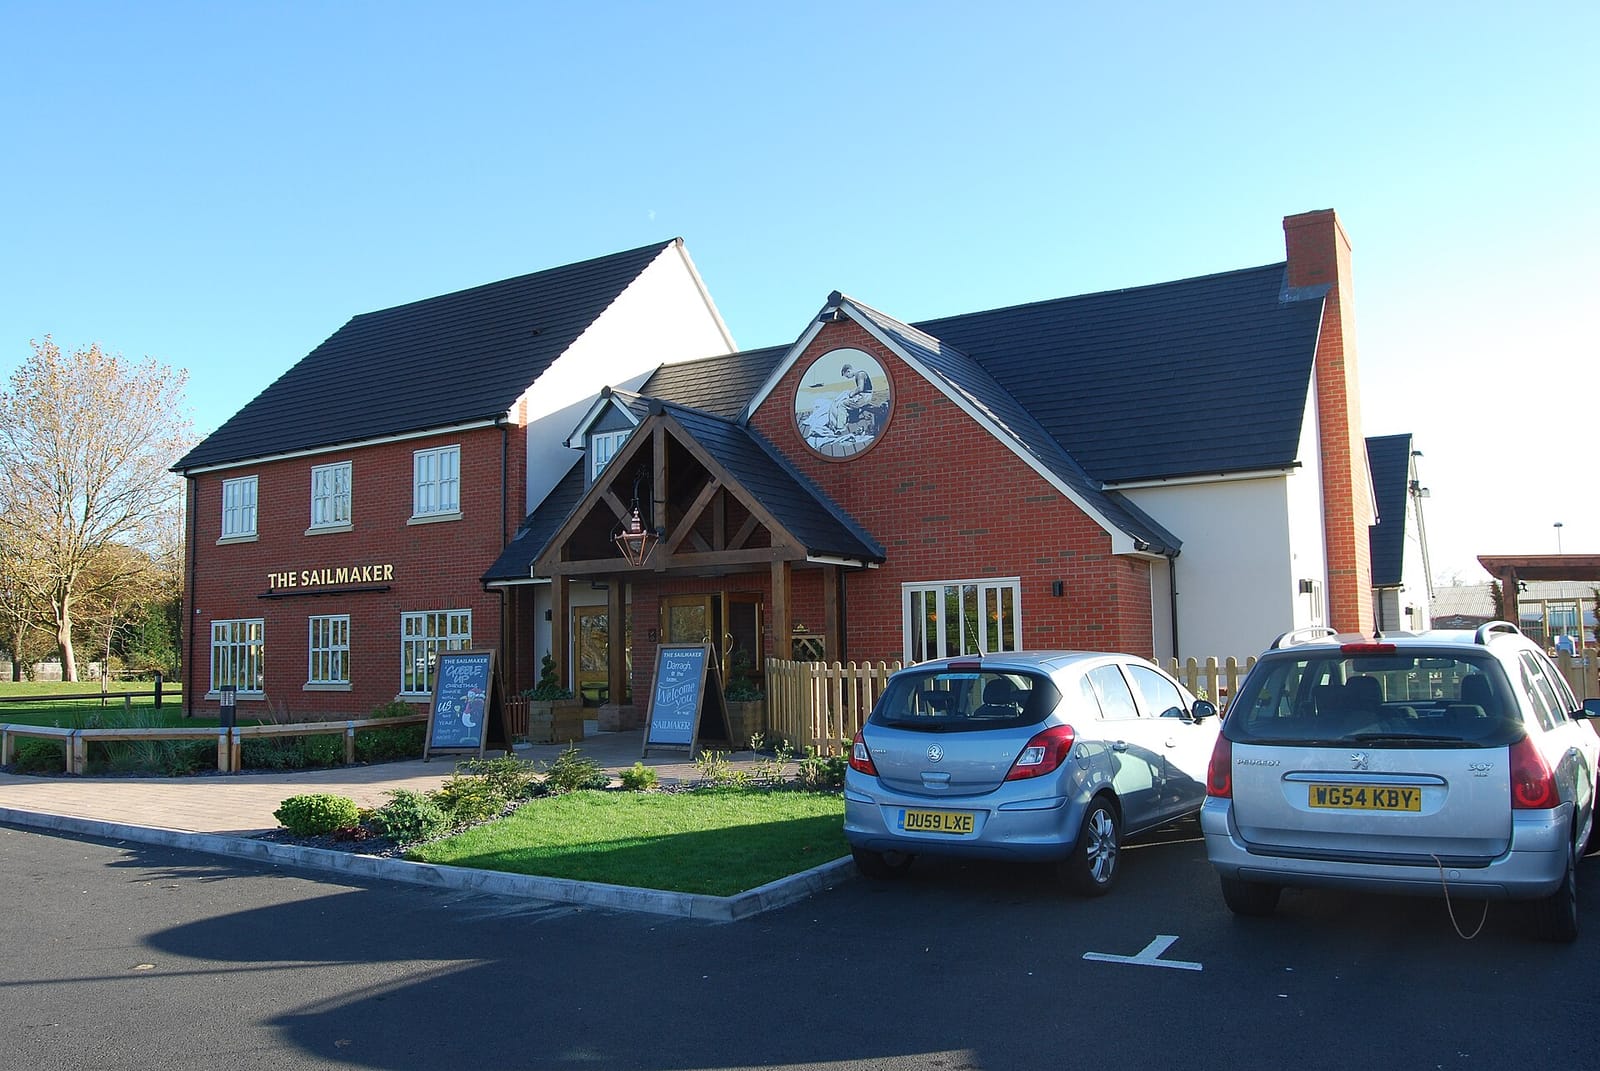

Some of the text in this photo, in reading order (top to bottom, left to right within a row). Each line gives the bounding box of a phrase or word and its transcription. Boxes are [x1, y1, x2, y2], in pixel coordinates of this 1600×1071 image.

[268, 564, 394, 589] THE SAILMAKER
[453, 675, 470, 684] UP
[656, 683, 695, 703] Welcome
[437, 700, 452, 713] US
[675, 695, 693, 709] you
[652, 720, 691, 730] SAILMAKER
[1236, 759, 1281, 767] PEUGEOT
[1467, 761, 1493, 771] 307
[1316, 787, 1414, 808] WG54 KBY
[906, 813, 972, 831] DU59 LXE
